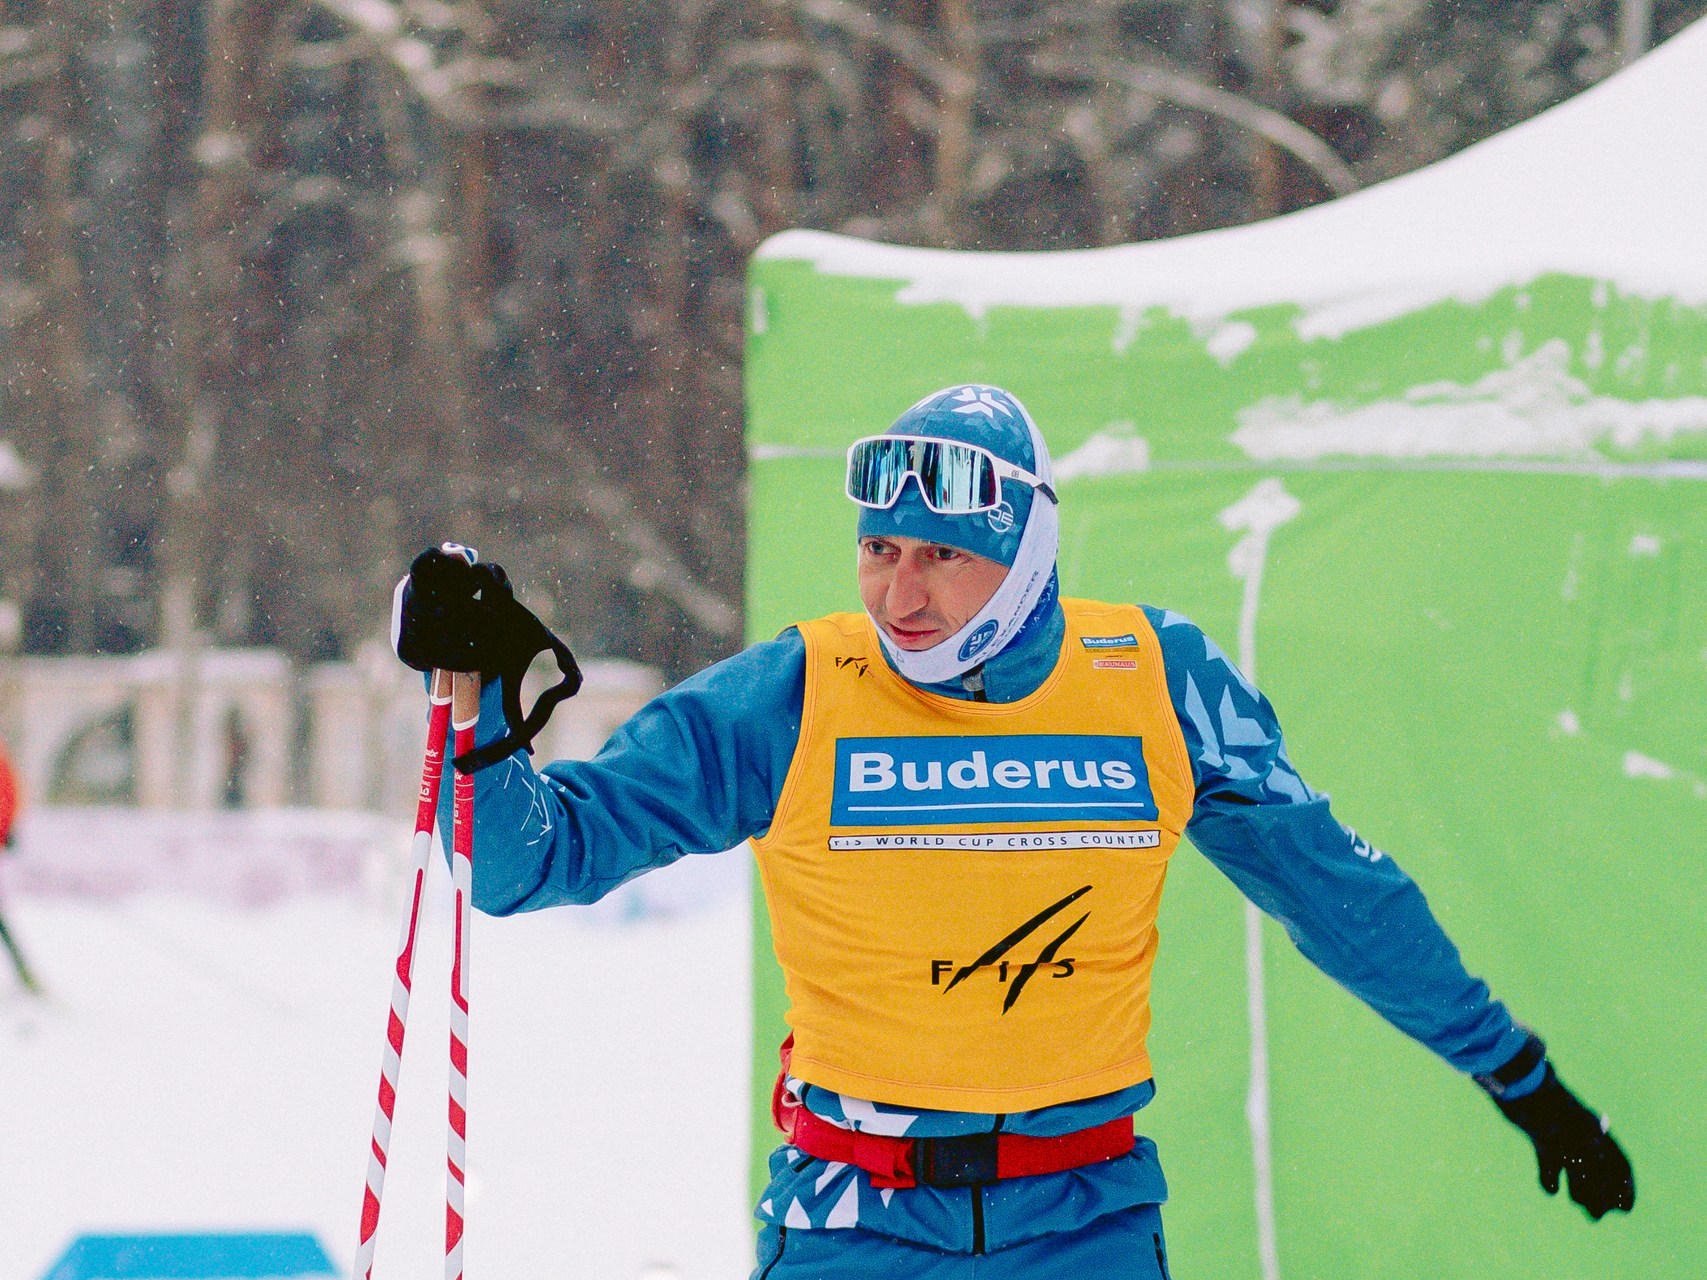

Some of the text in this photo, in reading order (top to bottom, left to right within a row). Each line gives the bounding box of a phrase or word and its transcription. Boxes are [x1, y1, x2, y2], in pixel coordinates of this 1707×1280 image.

[1082, 636, 1134, 645] Buderus
[849, 751, 1137, 792] Buderus
[876, 836, 945, 847] WORLD
[958, 837, 994, 847] CUP
[1007, 835, 1068, 847] CROSS
[1080, 834, 1155, 845] COUNTRY
